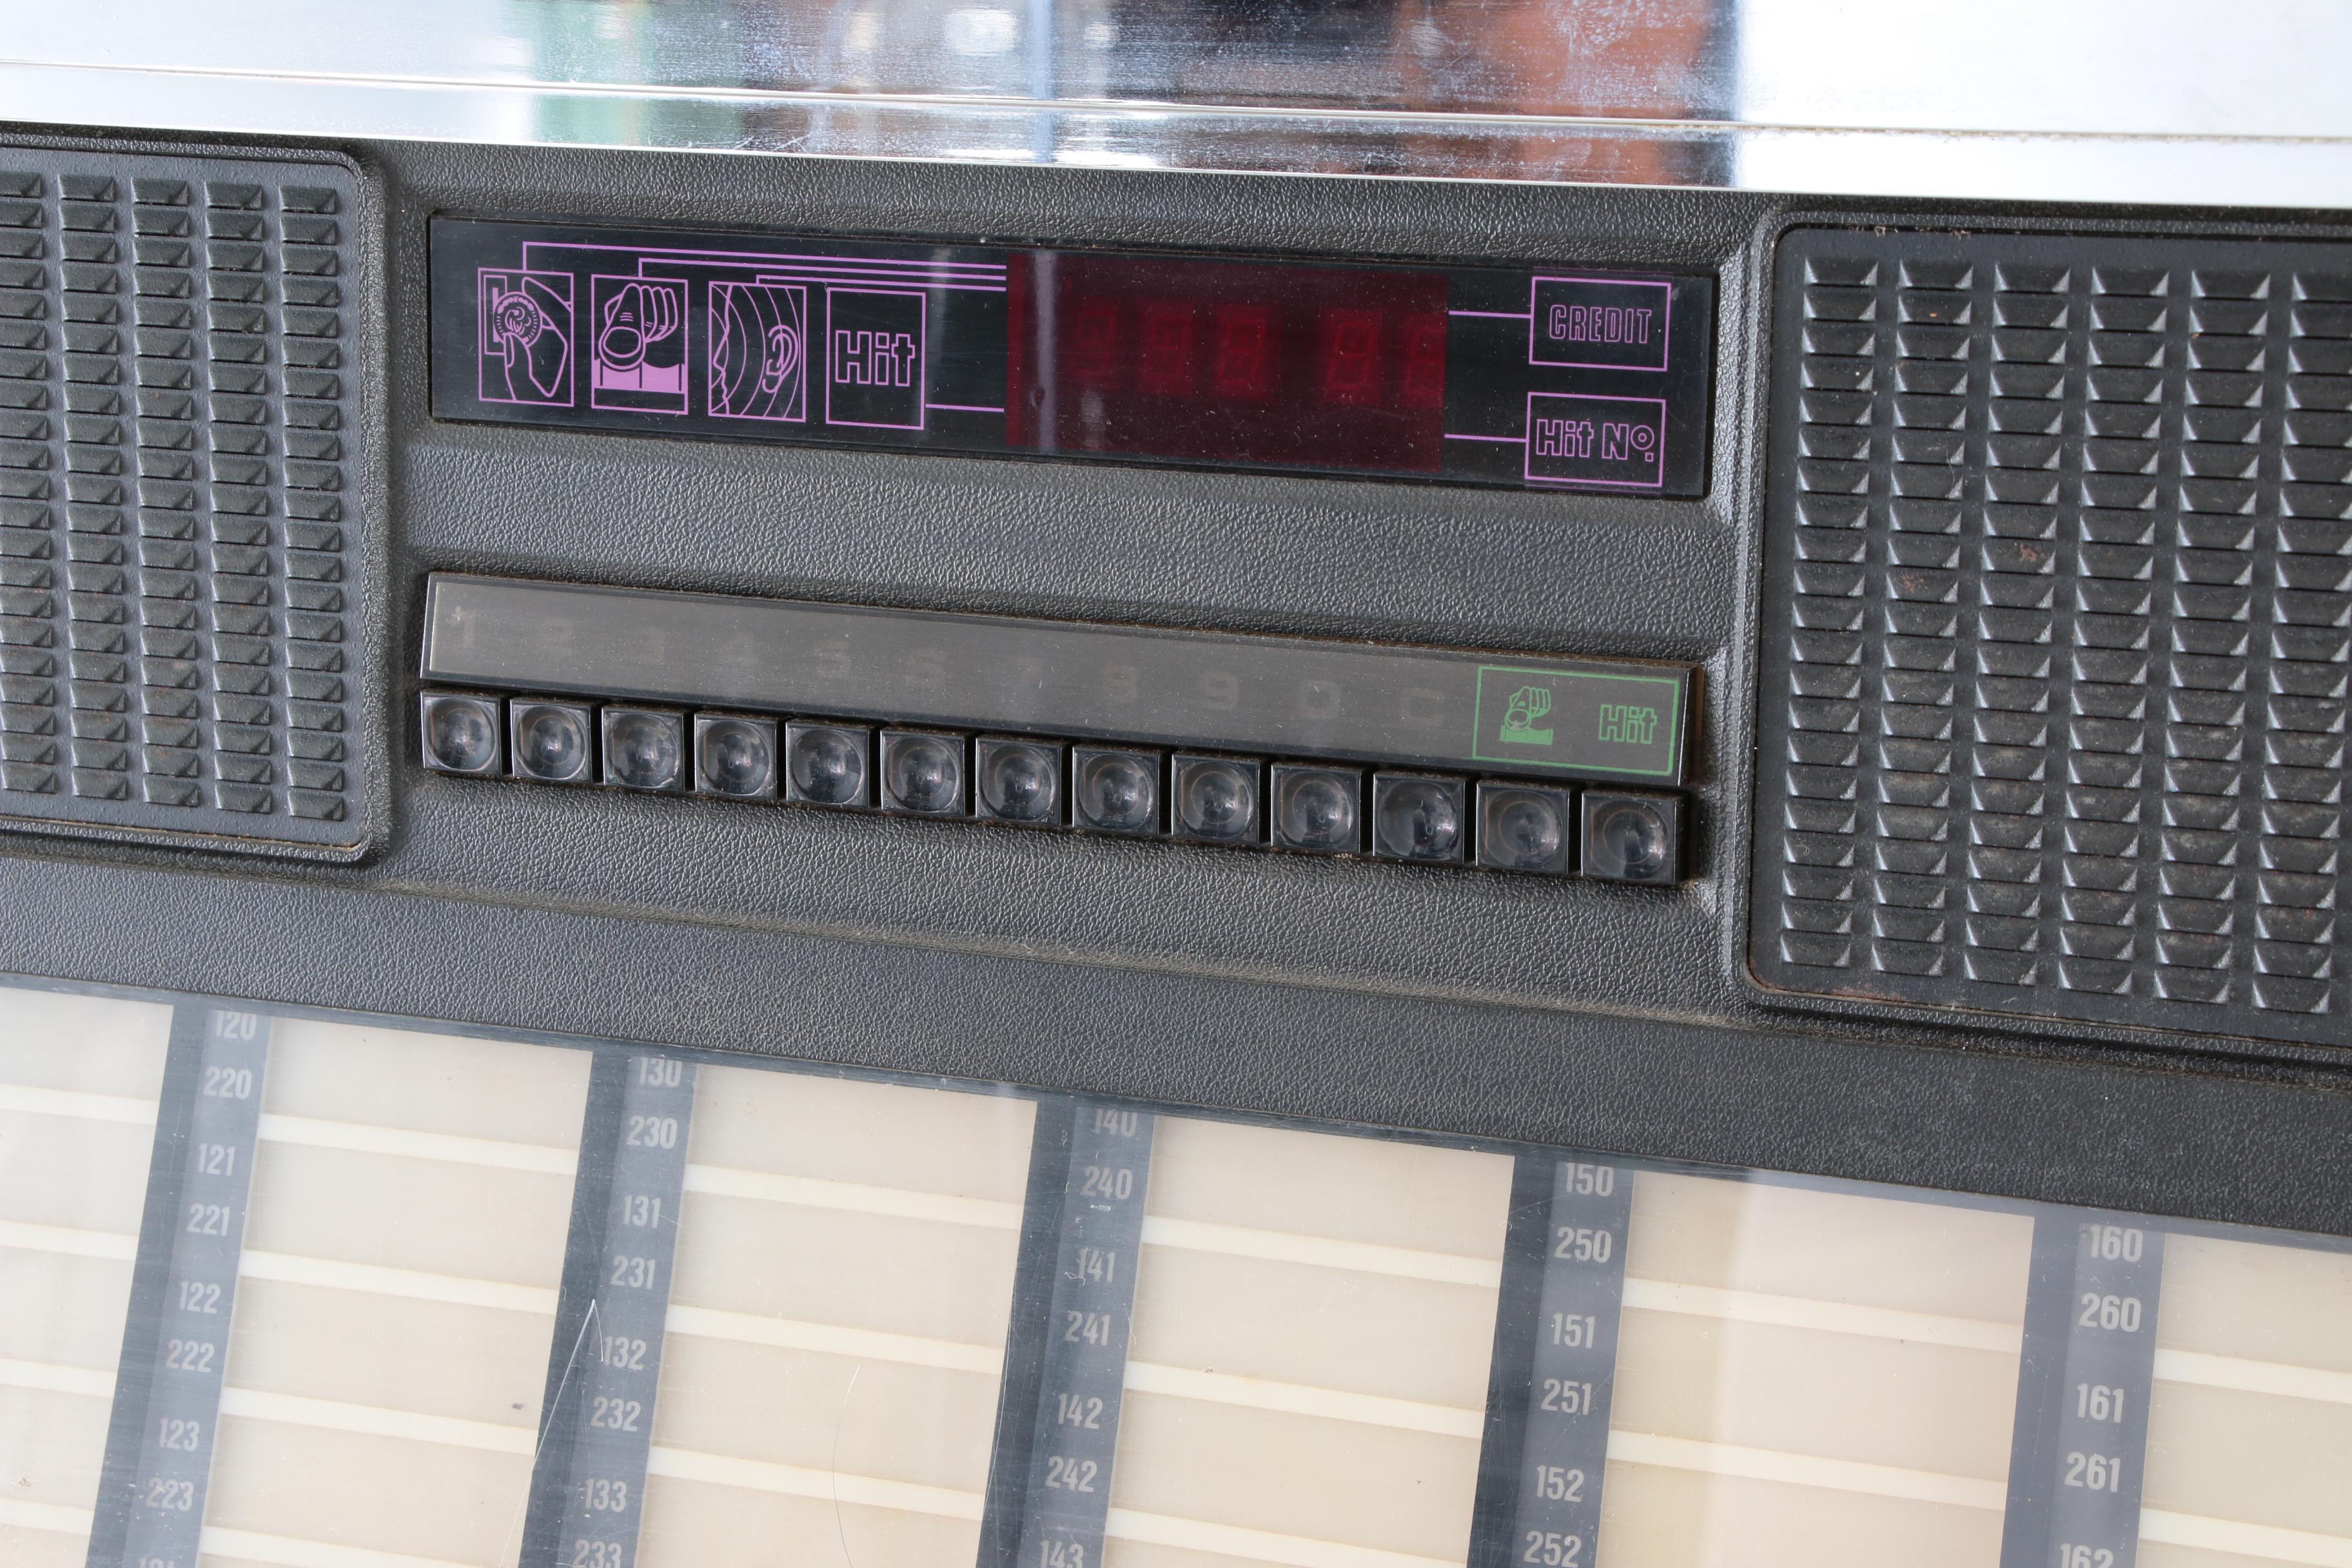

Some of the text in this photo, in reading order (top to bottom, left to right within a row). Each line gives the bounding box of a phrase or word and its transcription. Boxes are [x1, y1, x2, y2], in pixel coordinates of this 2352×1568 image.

[1549, 304, 1652, 344] CREDIT
[836, 330, 915, 387] Hit
[1536, 419, 1594, 458] Hit
[1200, 671, 1239, 712] 9
[1400, 687, 1444, 729] C
[1598, 704, 1658, 744] Hit
[216, 1011, 257, 1040] 120
[202, 1067, 251, 1100] 220
[639, 1058, 682, 1088] 130
[625, 1116, 678, 1150] 230
[1095, 1109, 1137, 1138] 140
[198, 1143, 236, 1177] 121
[1081, 1166, 1132, 1200] 240
[1565, 1162, 1613, 1197] 150
[186, 1204, 230, 1237] 221
[623, 1195, 662, 1229] 131
[1554, 1227, 1612, 1263] 250
[2090, 1225, 2143, 1263] 160
[610, 1255, 656, 1290] 231
[1079, 1249, 1115, 1283] 141
[179, 1280, 221, 1314] 122
[2079, 1293, 2142, 1332] 260
[1064, 1311, 1109, 1346] 241
[1553, 1313, 1595, 1349] 151
[165, 1339, 215, 1373] 222
[602, 1335, 647, 1370] 132
[590, 1397, 642, 1432] 232
[1058, 1393, 1103, 1429] 142
[1541, 1378, 1592, 1416] 251
[2077, 1384, 2124, 1423] 161
[159, 1418, 201, 1451] 123
[1045, 1456, 1097, 1493] 242
[1536, 1465, 1584, 1502] 152
[2064, 1452, 2121, 1493] 261
[145, 1477, 195, 1511] 223
[585, 1478, 627, 1512] 133
[573, 1539, 622, 1568] 233
[1524, 1531, 1582, 1568] 252
